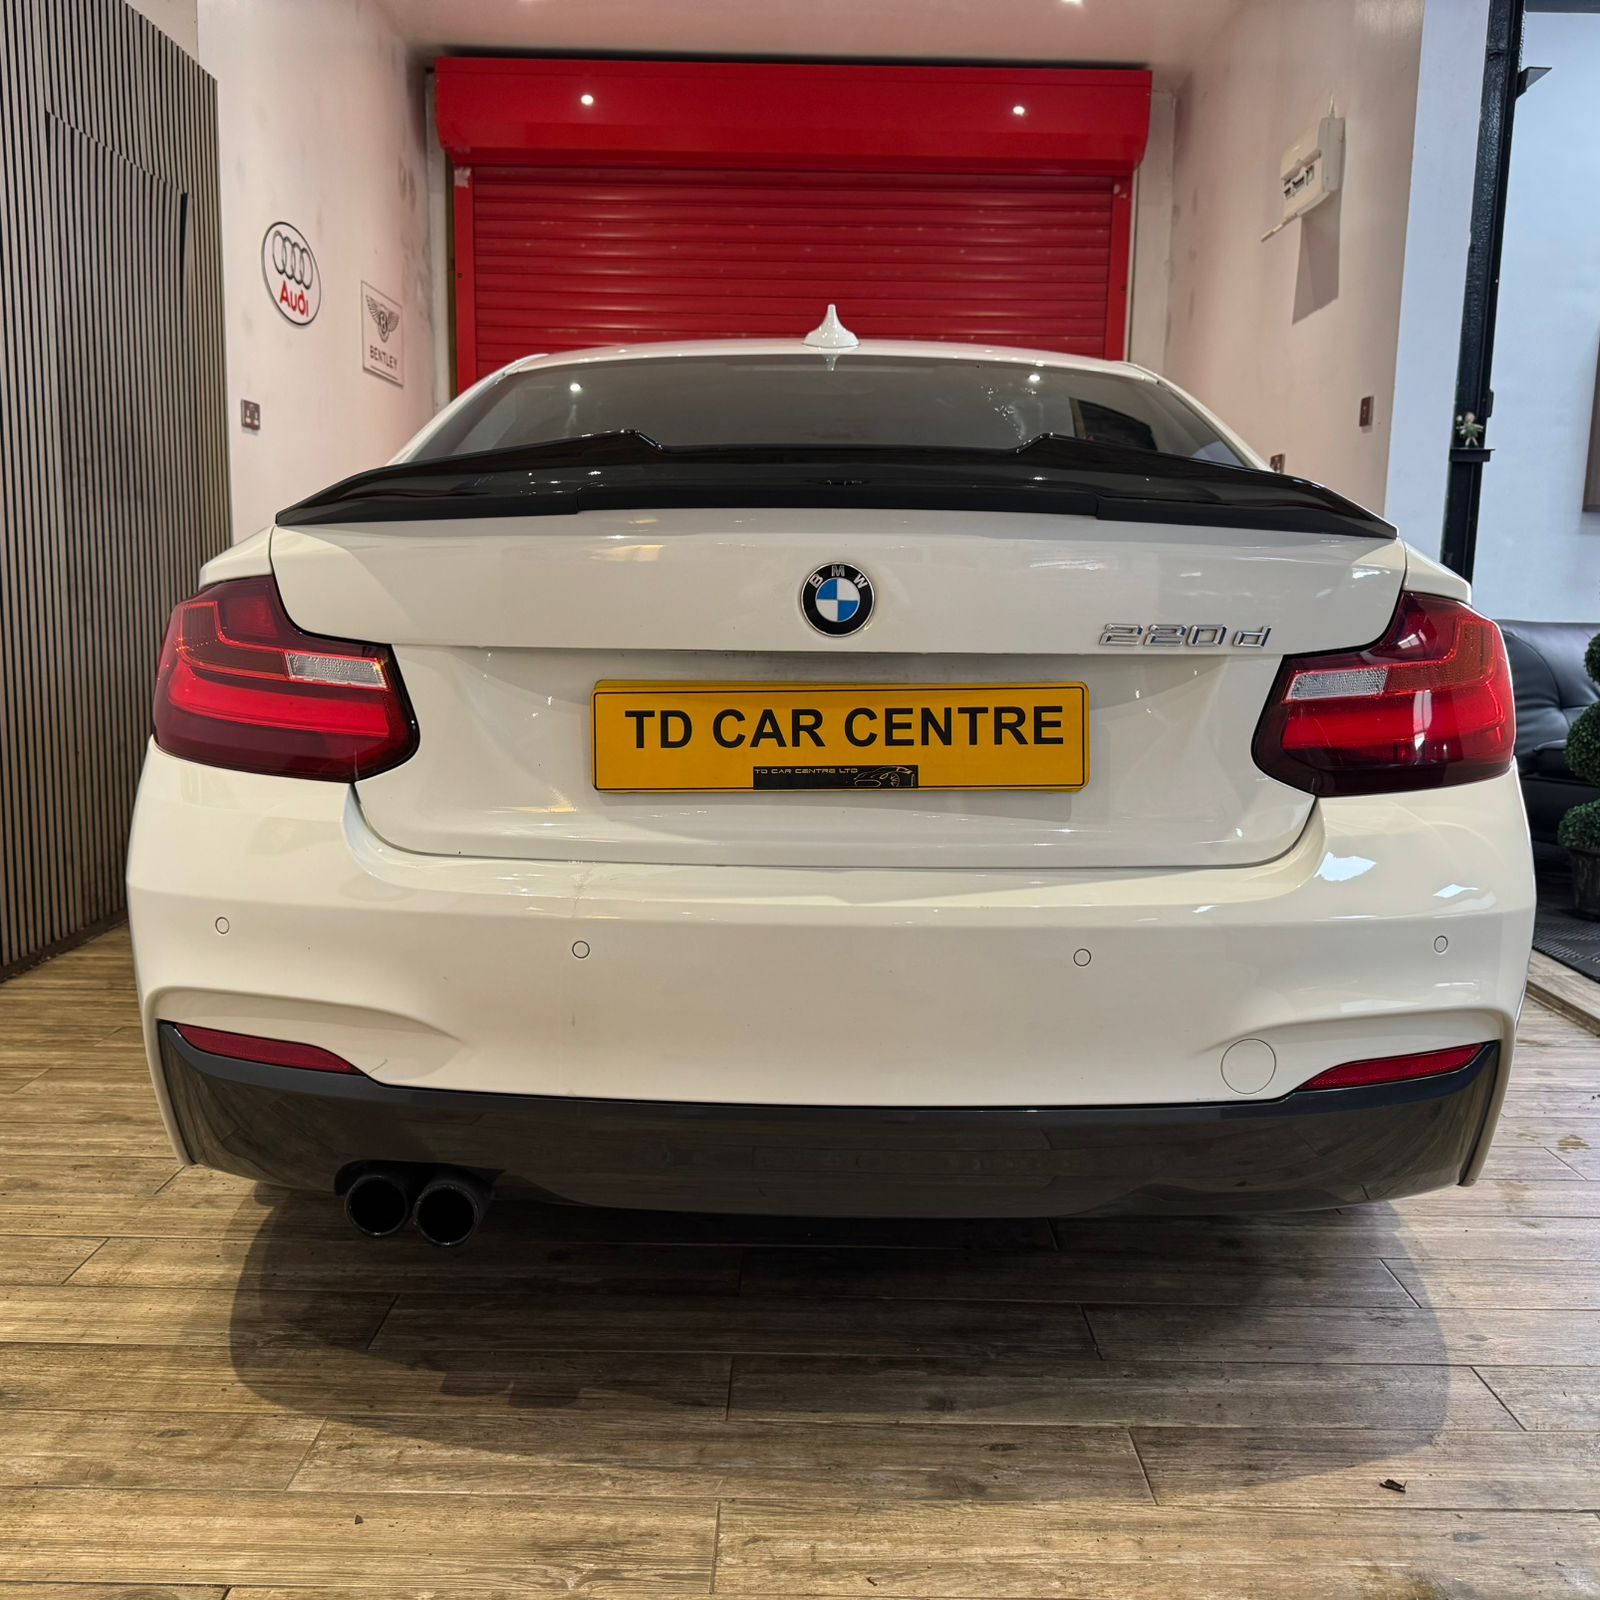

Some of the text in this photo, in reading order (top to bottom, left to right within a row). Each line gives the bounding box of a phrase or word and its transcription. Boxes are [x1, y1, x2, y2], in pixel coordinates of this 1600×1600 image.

[280, 280, 309, 317] Audi
[369, 345, 397, 370] BENTLEY
[809, 565, 868, 589] BMW
[625, 705, 1064, 749] TD CAR CENTRE
